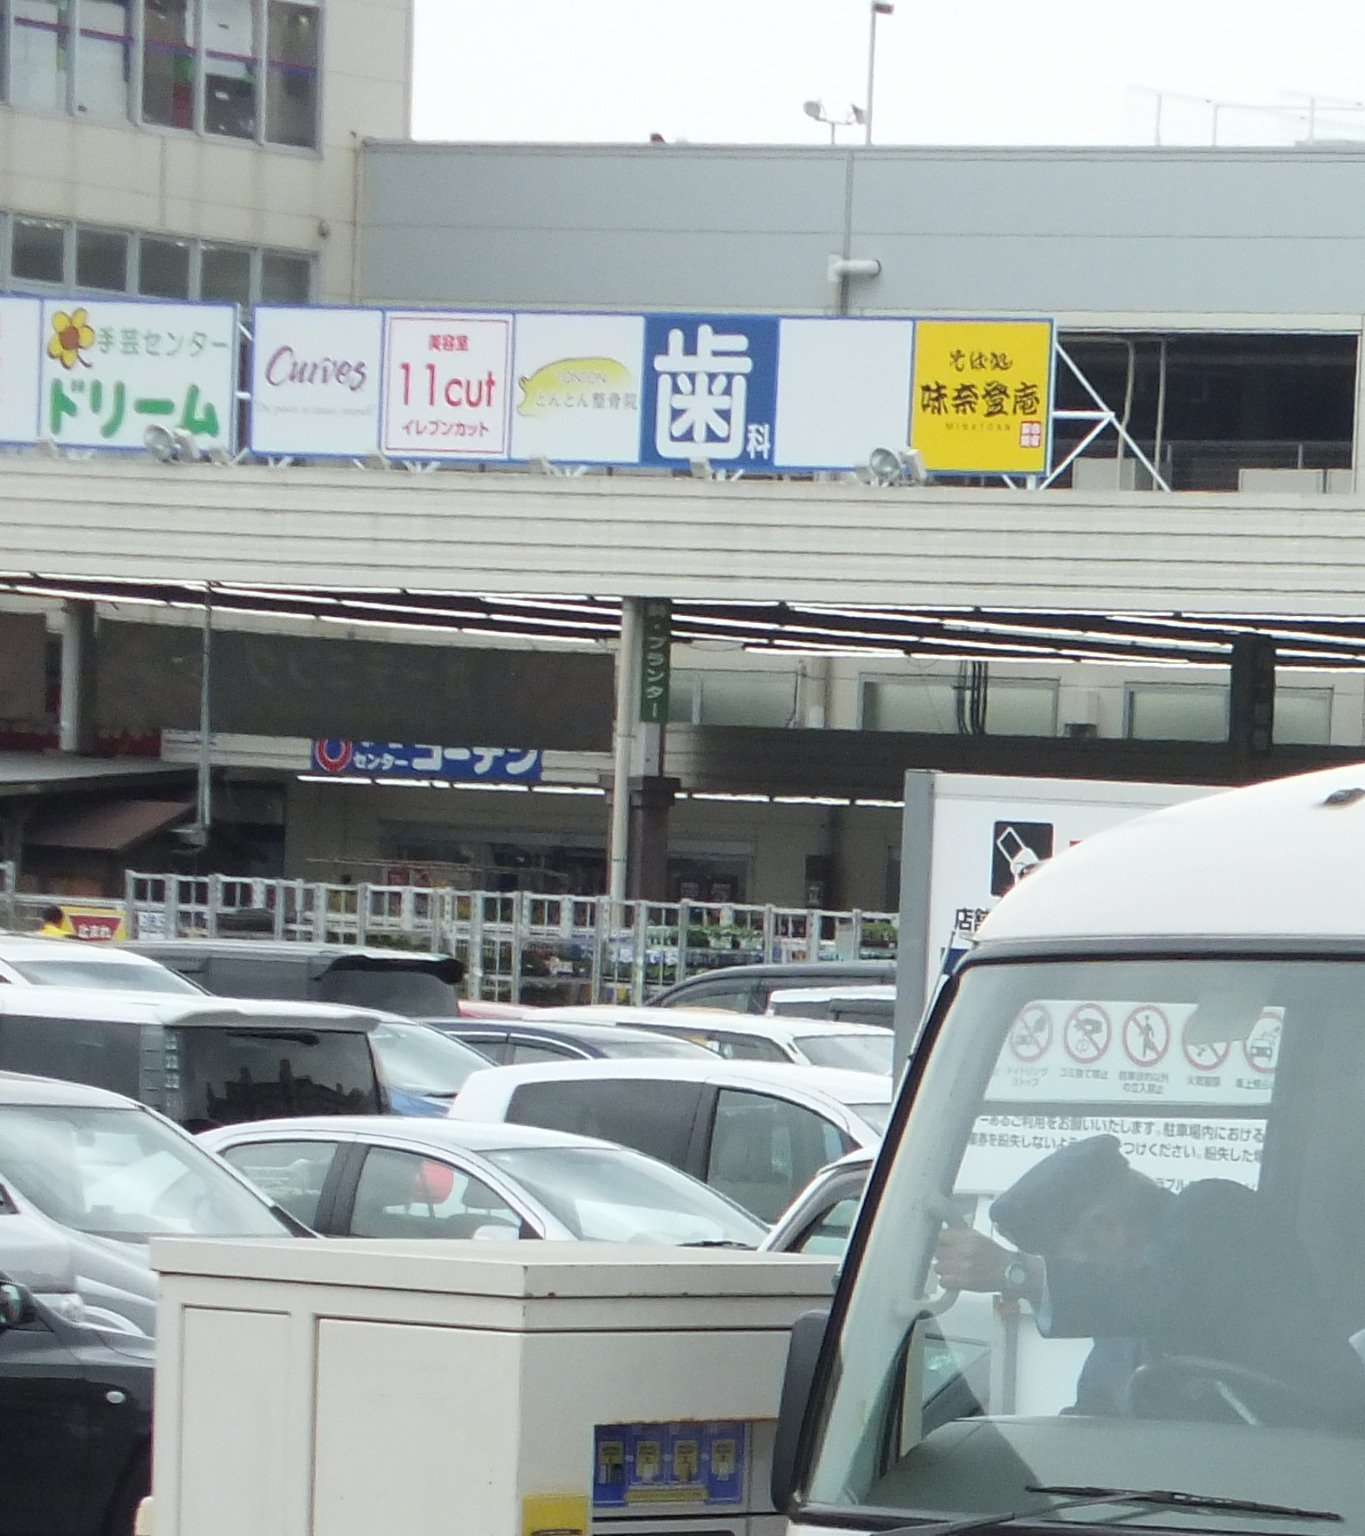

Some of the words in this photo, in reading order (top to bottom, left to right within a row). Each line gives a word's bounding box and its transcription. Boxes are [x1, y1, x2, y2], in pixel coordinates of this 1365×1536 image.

[97, 326, 229, 357] 手芸センター
[427, 334, 470, 353] 美容室
[264, 344, 368, 392] Curves
[949, 349, 1014, 372] そば処
[48, 377, 220, 439] ドリーム
[920, 380, 1041, 418] 味奈登庵
[402, 419, 490, 438] イレブンカット
